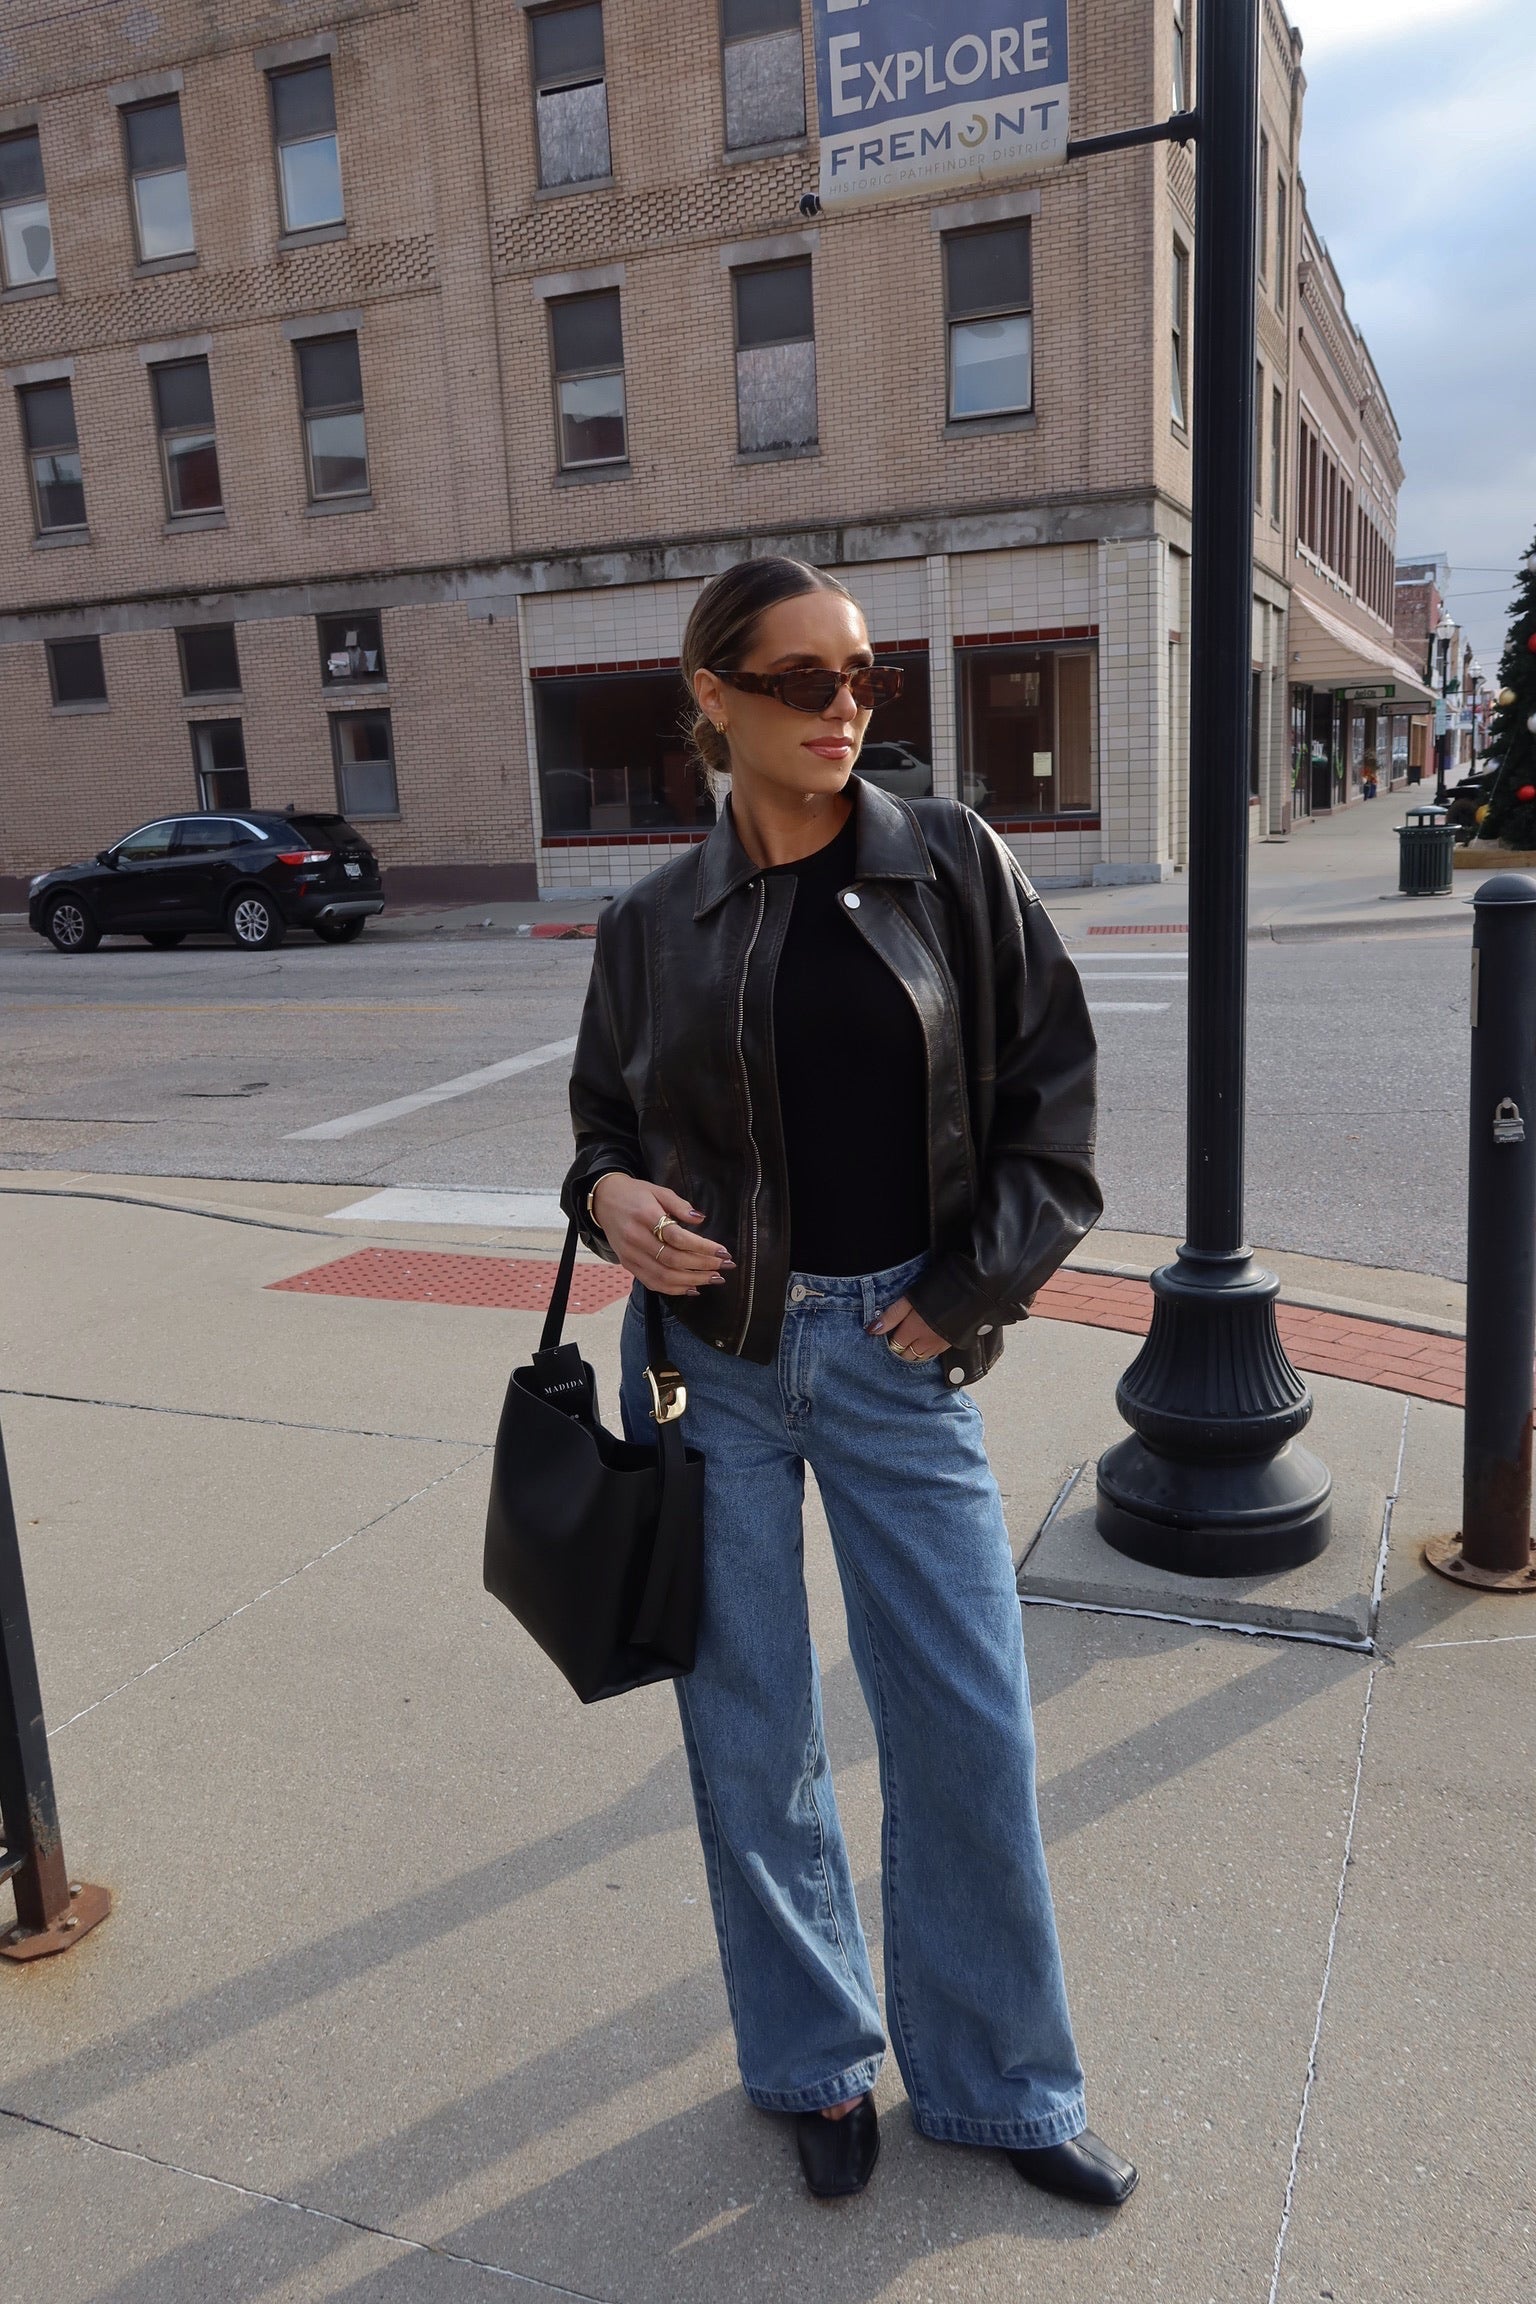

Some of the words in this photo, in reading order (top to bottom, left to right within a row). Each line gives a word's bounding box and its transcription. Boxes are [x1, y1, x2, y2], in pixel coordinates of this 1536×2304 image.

[829, 17, 1049, 117] EXPLORE
[829, 174, 892, 195] HISTORIC
[900, 154, 985, 181] PATHFINDER
[993, 138, 1057, 161] DISTRICT
[544, 1378, 584, 1394] MADIDA
